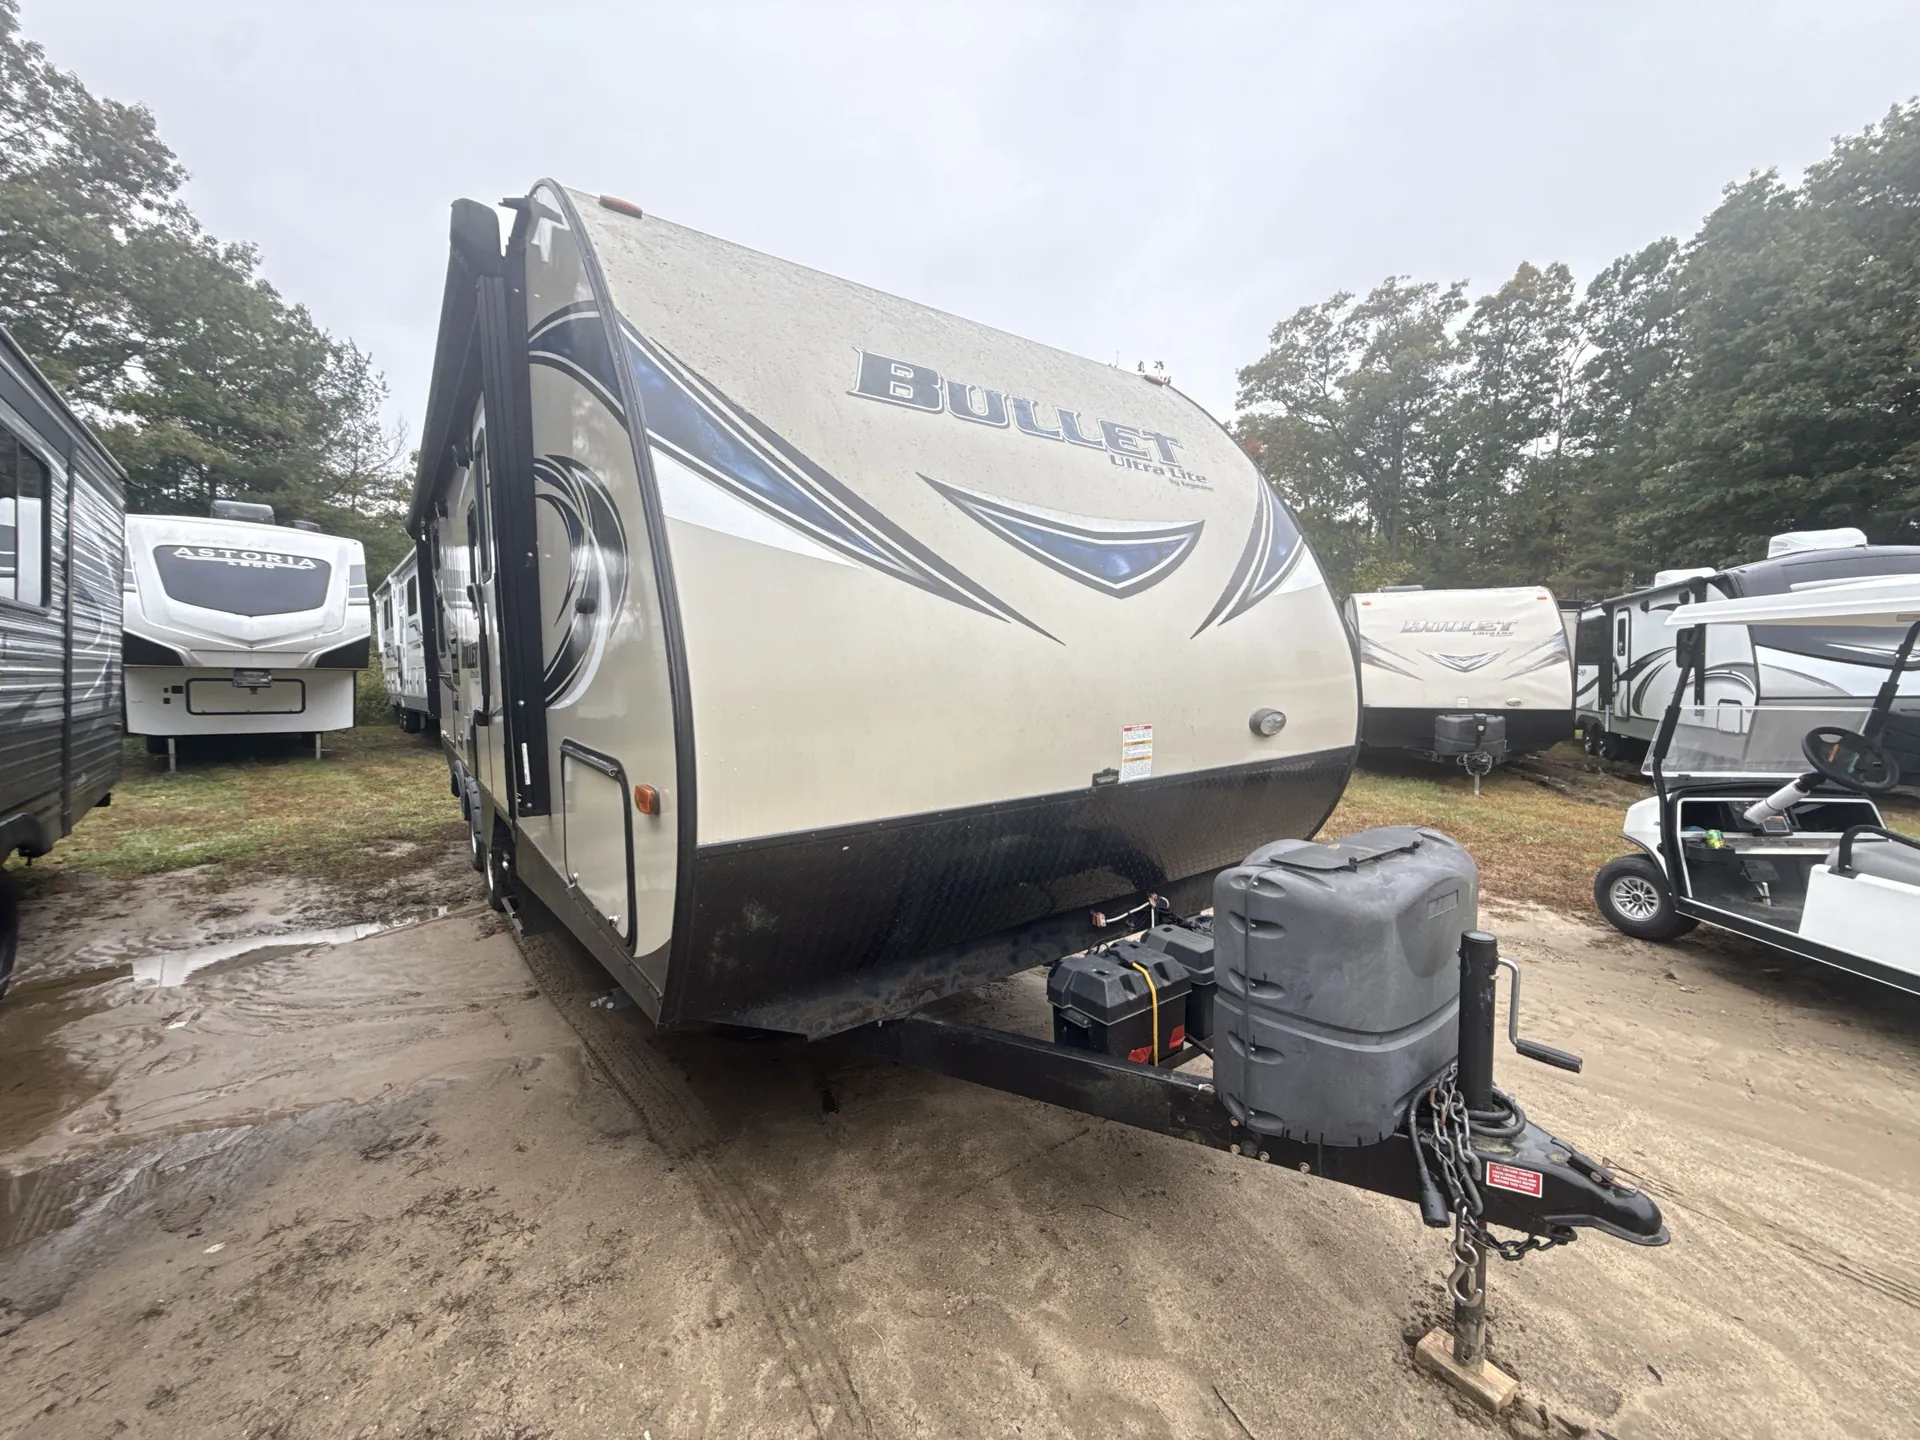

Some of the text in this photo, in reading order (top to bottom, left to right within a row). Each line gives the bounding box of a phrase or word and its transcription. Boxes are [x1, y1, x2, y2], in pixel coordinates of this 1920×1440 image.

[846, 346, 1184, 468] BULLET
[1110, 454, 1208, 484] Ultra Lite
[173, 547, 317, 568] ASTORIA
[1400, 619, 1518, 633] BULLET
